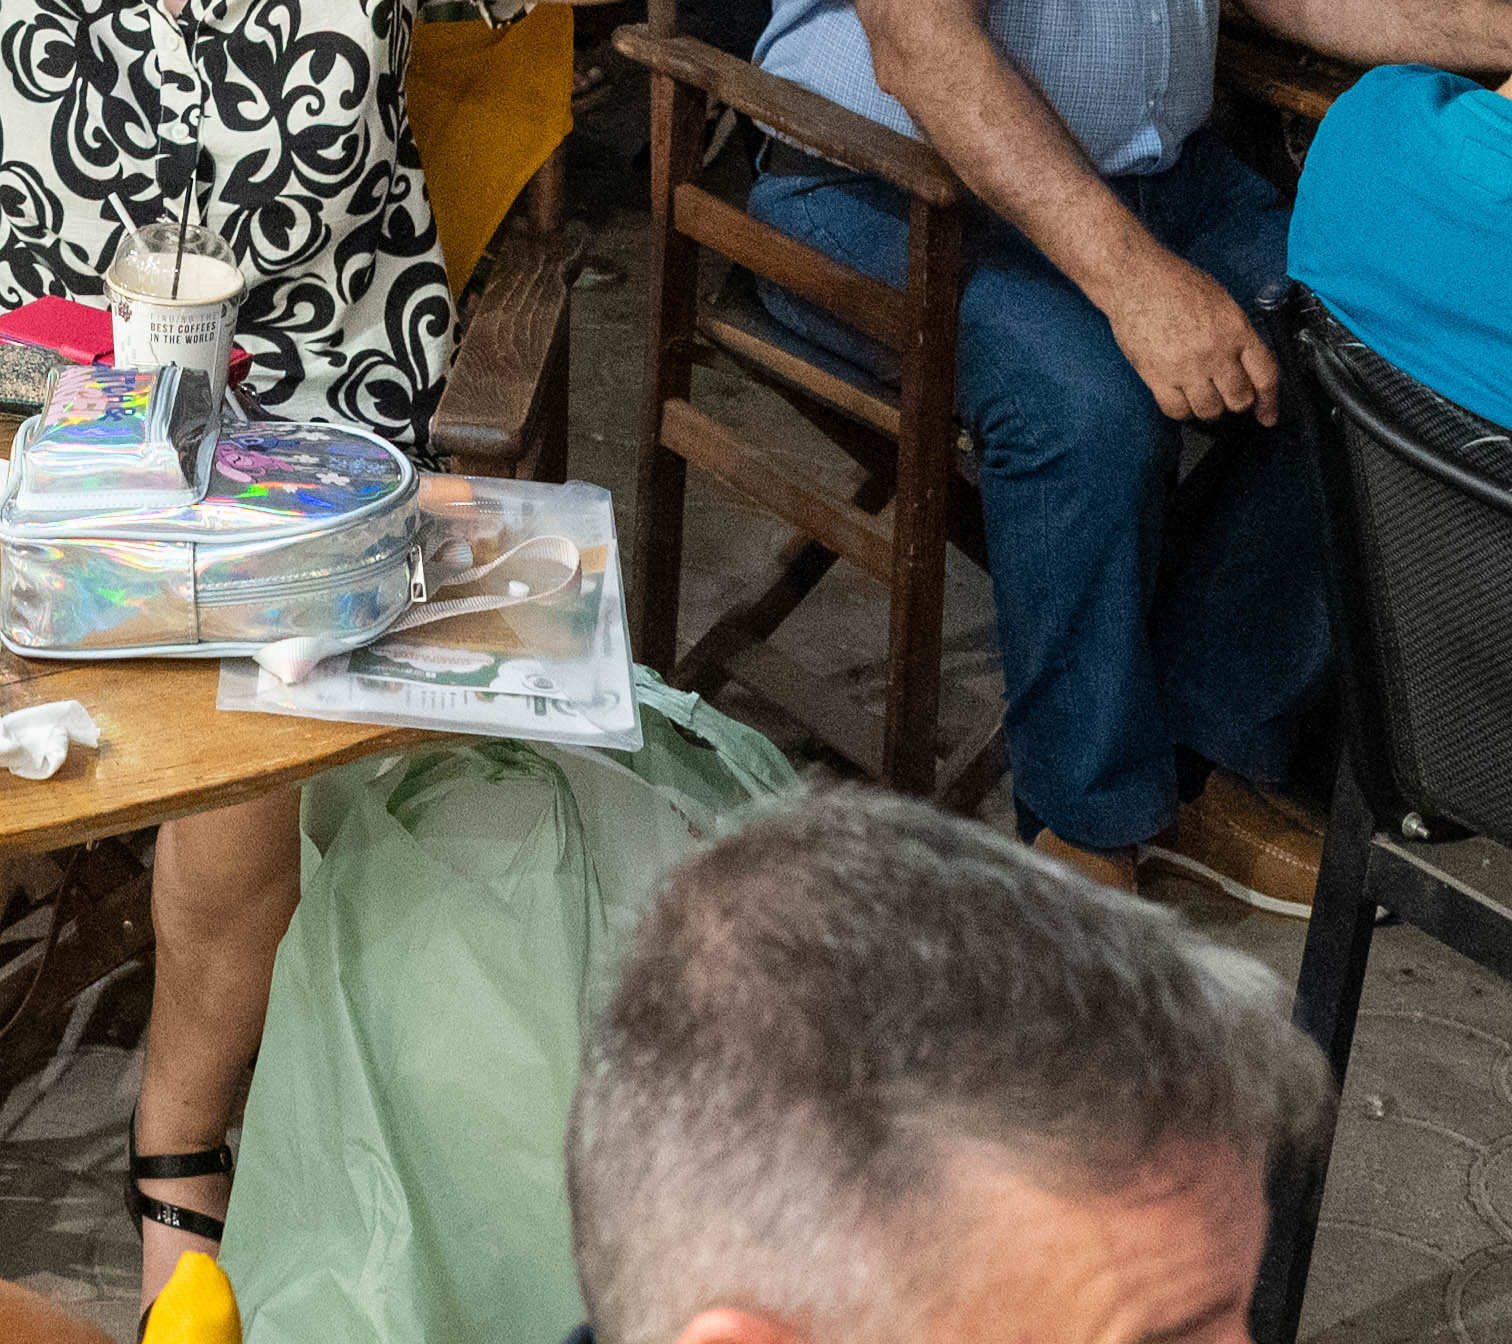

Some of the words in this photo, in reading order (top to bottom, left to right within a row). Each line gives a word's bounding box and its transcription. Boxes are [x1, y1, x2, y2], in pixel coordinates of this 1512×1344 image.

[150, 322, 175, 333] BEST
[177, 321, 217, 333] COFFEES
[150, 332, 160, 343] IN
[164, 333, 181, 344] THE
[184, 332, 216, 344] WORLD
